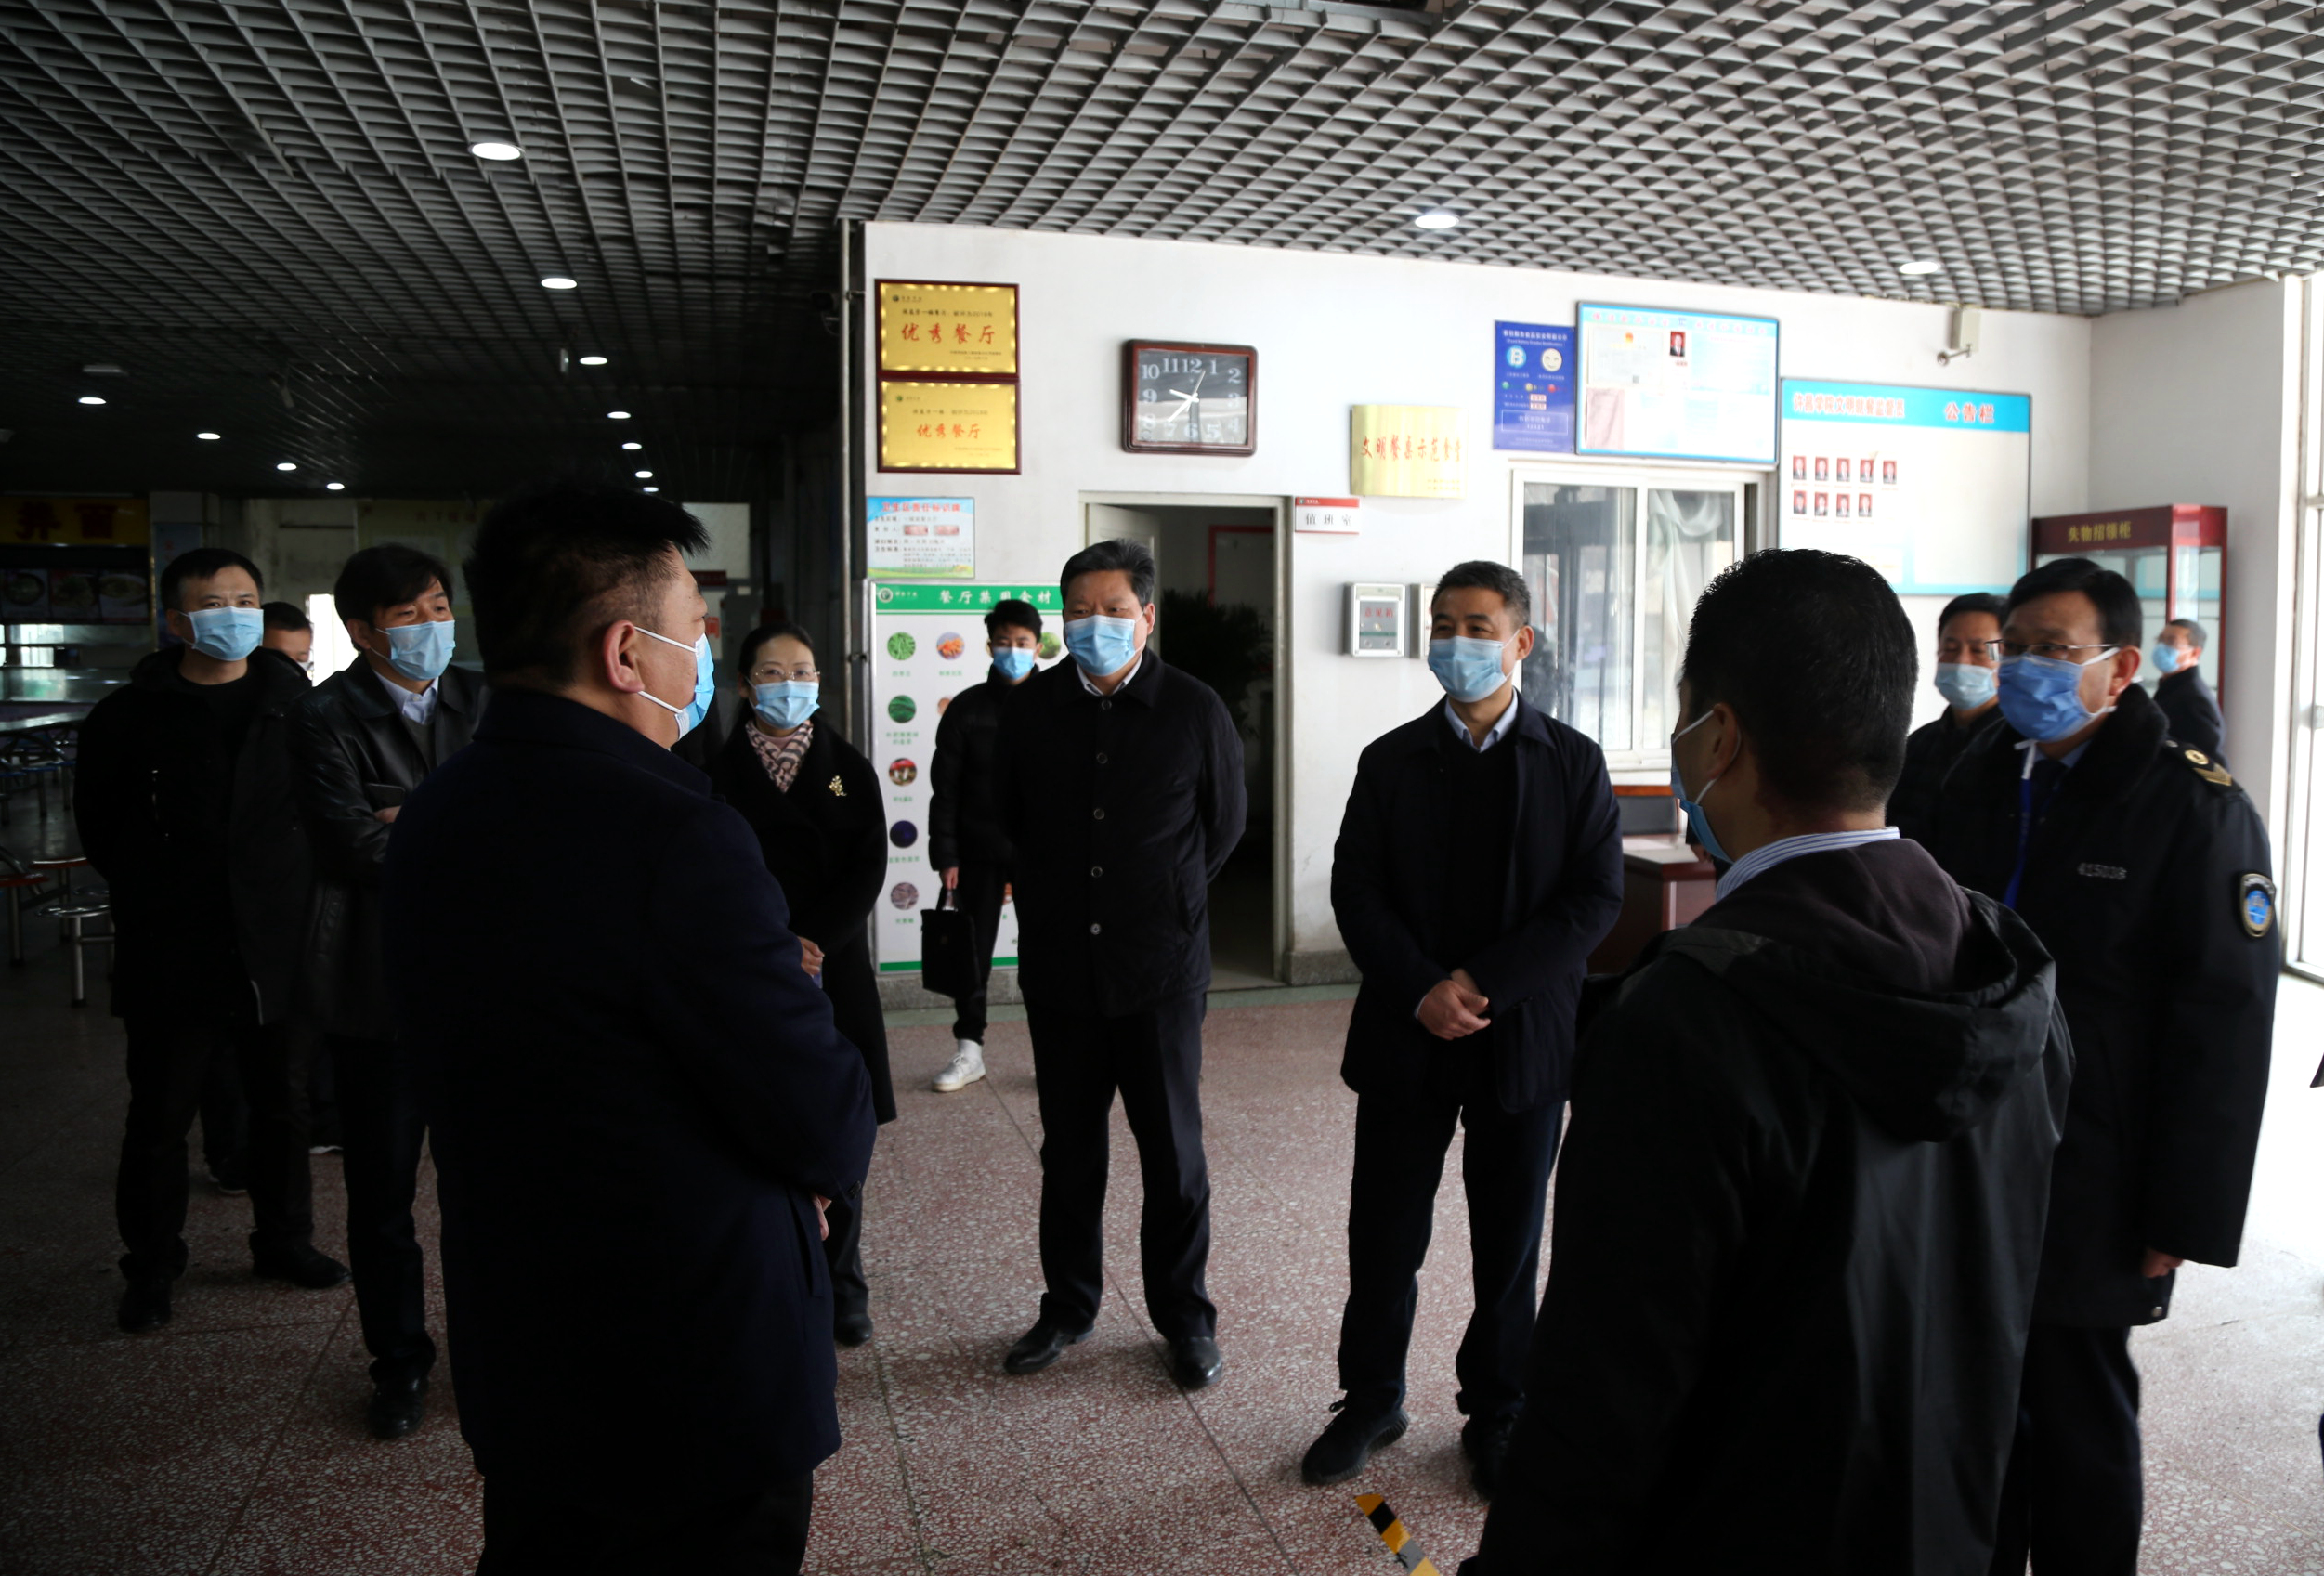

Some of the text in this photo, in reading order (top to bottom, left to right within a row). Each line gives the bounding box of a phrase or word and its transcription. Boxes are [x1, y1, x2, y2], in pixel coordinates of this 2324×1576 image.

[901, 322, 995, 345] 优秀餐厅
[1510, 347, 1524, 366] B
[1142, 363, 1160, 380] 10
[1163, 358, 1219, 375] 11 12 1
[1228, 367, 1242, 384] 2
[1142, 388, 1158, 405] 9
[1793, 392, 1995, 423] 许昌学院文明就餐监督员 公告栏
[916, 423, 981, 439] 优秀餐厅
[1184, 423, 1199, 439] 6
[1208, 423, 1221, 439] 5
[1360, 435, 1462, 462] 文明餐桌示范食堂
[1305, 513, 1351, 527] 值班室
[2068, 520, 2132, 543] 失物招领柜
